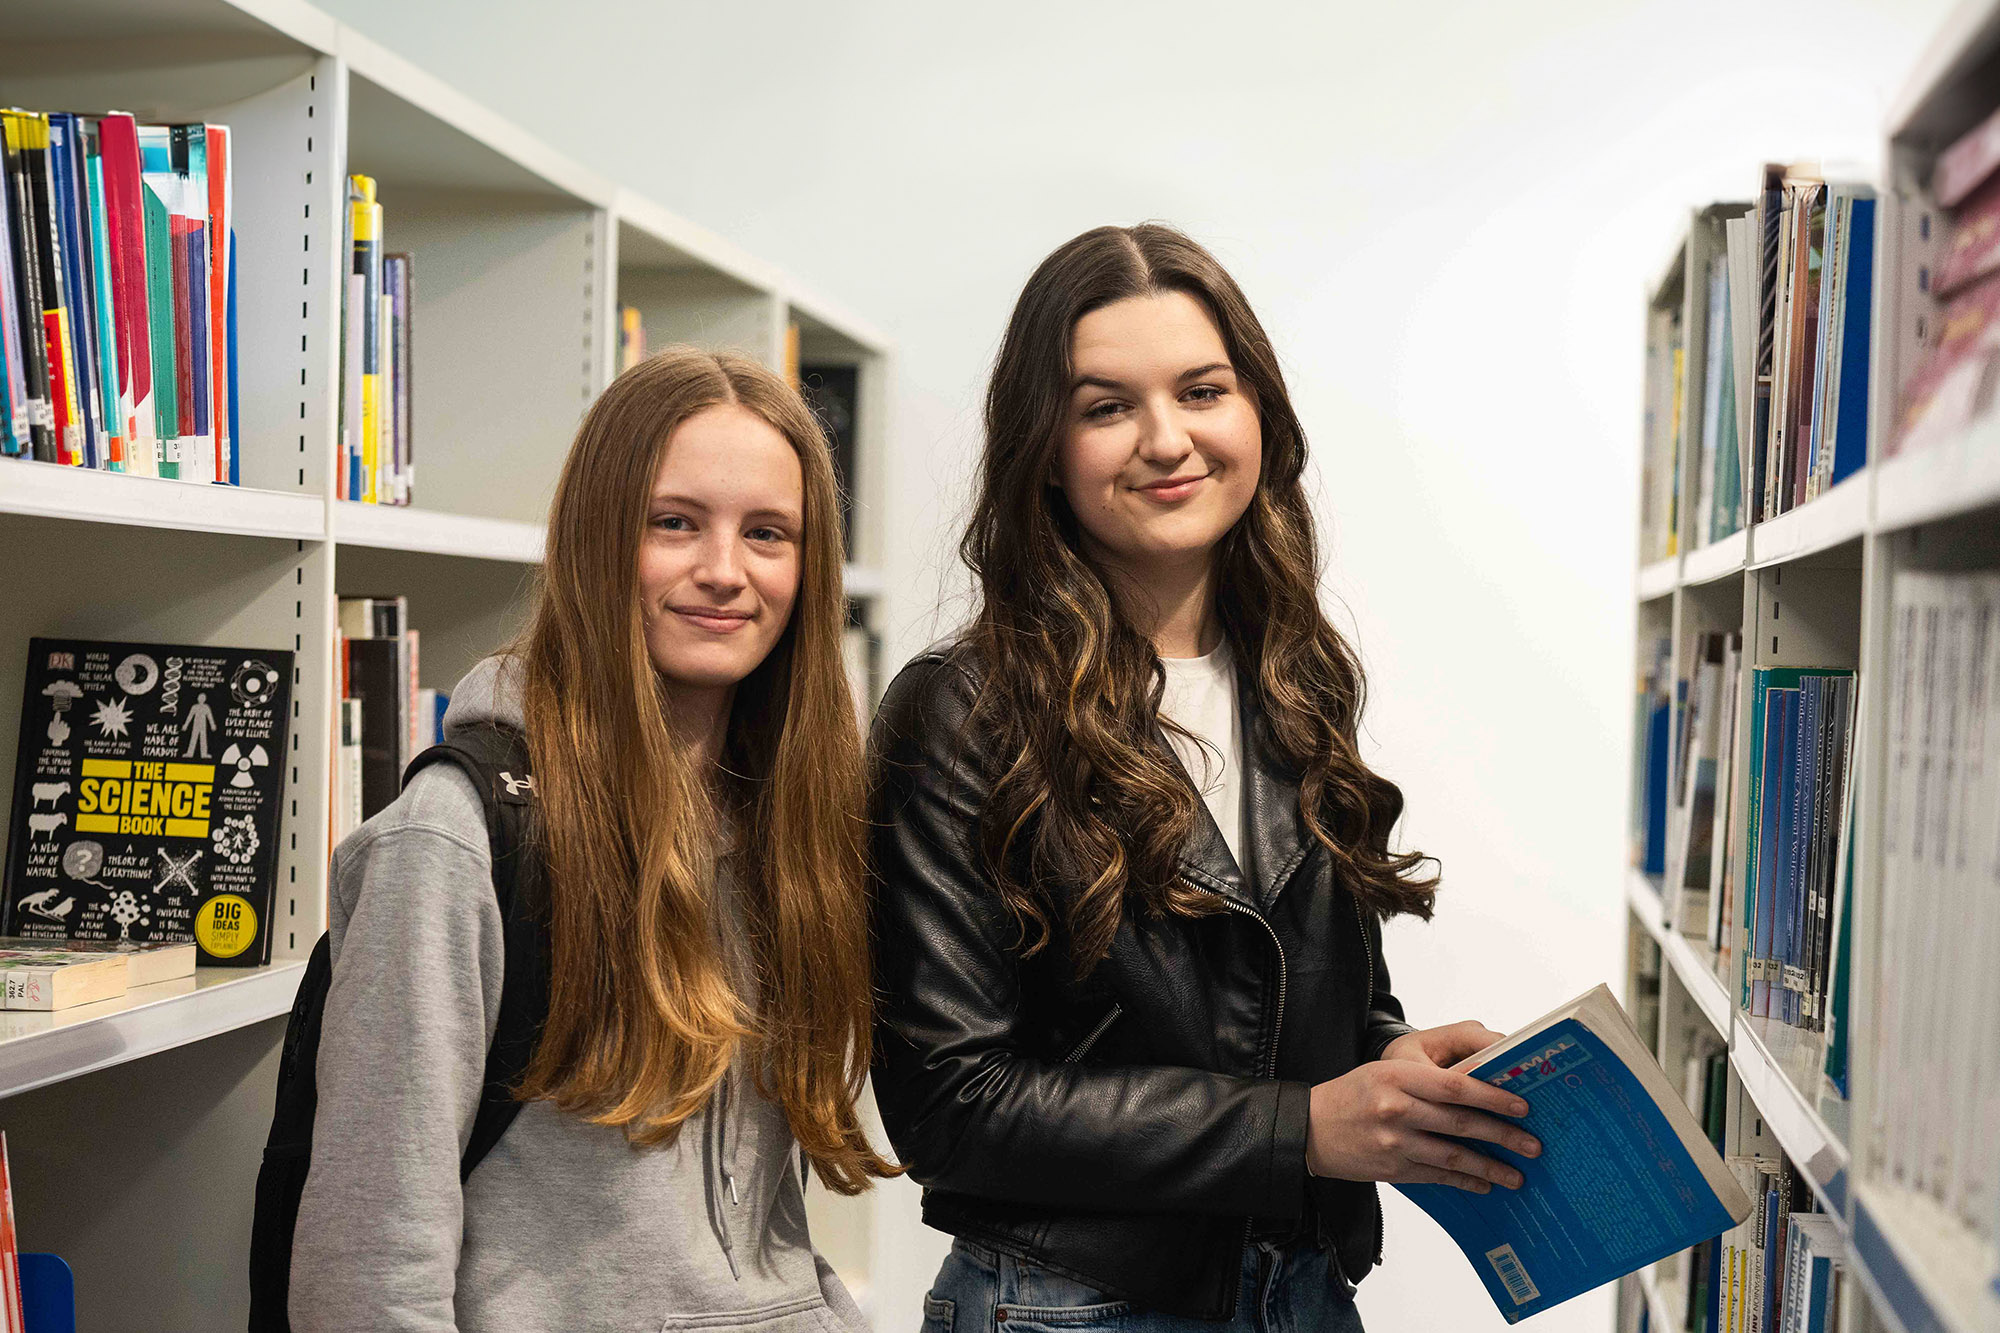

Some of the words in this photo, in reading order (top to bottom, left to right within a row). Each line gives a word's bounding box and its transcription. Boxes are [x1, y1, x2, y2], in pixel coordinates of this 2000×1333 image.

[49, 652, 72, 668] DK
[85, 663, 109, 672] BEYOND
[229, 708, 241, 717] THE
[243, 709, 261, 717] ORBIT
[264, 710, 272, 718] OF
[225, 718, 245, 727] EVERY
[248, 720, 273, 728] PLANET
[146, 724, 158, 734] WE
[164, 724, 179, 734] ARE
[233, 729, 244, 737] AN
[144, 736, 166, 746] MADE
[169, 736, 179, 746] OF
[1795, 691, 1806, 783] Understanding
[1805, 693, 1813, 787] Understanding
[142, 747, 178, 758] STARDUST
[39, 757, 50, 765] THE
[52, 758, 72, 766] SPRING
[47, 766, 57, 774] THE
[60, 767, 71, 775] AIR
[134, 762, 164, 780] THE
[78, 778, 213, 818] SCIENCE
[1823, 782, 1831, 842] Welfare
[120, 816, 164, 836] BOOK
[30, 842, 37, 852] A
[40, 843, 59, 853] NEW
[126, 844, 133, 853] A
[28, 855, 46, 864] LAW
[48, 856, 58, 865] OF
[108, 855, 136, 866] THEORY
[139, 857, 148, 866] OF
[1790, 841, 1798, 889] Welfare
[26, 867, 58, 877] NATURE
[215, 865, 234, 873] INSERT
[236, 866, 253, 874] GENES
[229, 884, 251, 892] DISEASE
[168, 897, 181, 906] THE
[156, 909, 190, 918] UNIVERSE
[215, 903, 241, 919] BIG
[86, 922, 104, 930] PLANT
[213, 920, 240, 930] IDEAS
[148, 932, 163, 940] AND
[166, 933, 194, 942] GETTING
[211, 931, 239, 941] SIMPLY
[1757, 1194, 1765, 1246] ACKERMAN
[1788, 1239, 1799, 1309] ANIMAL
[1753, 1254, 1761, 1312] COMPANION
